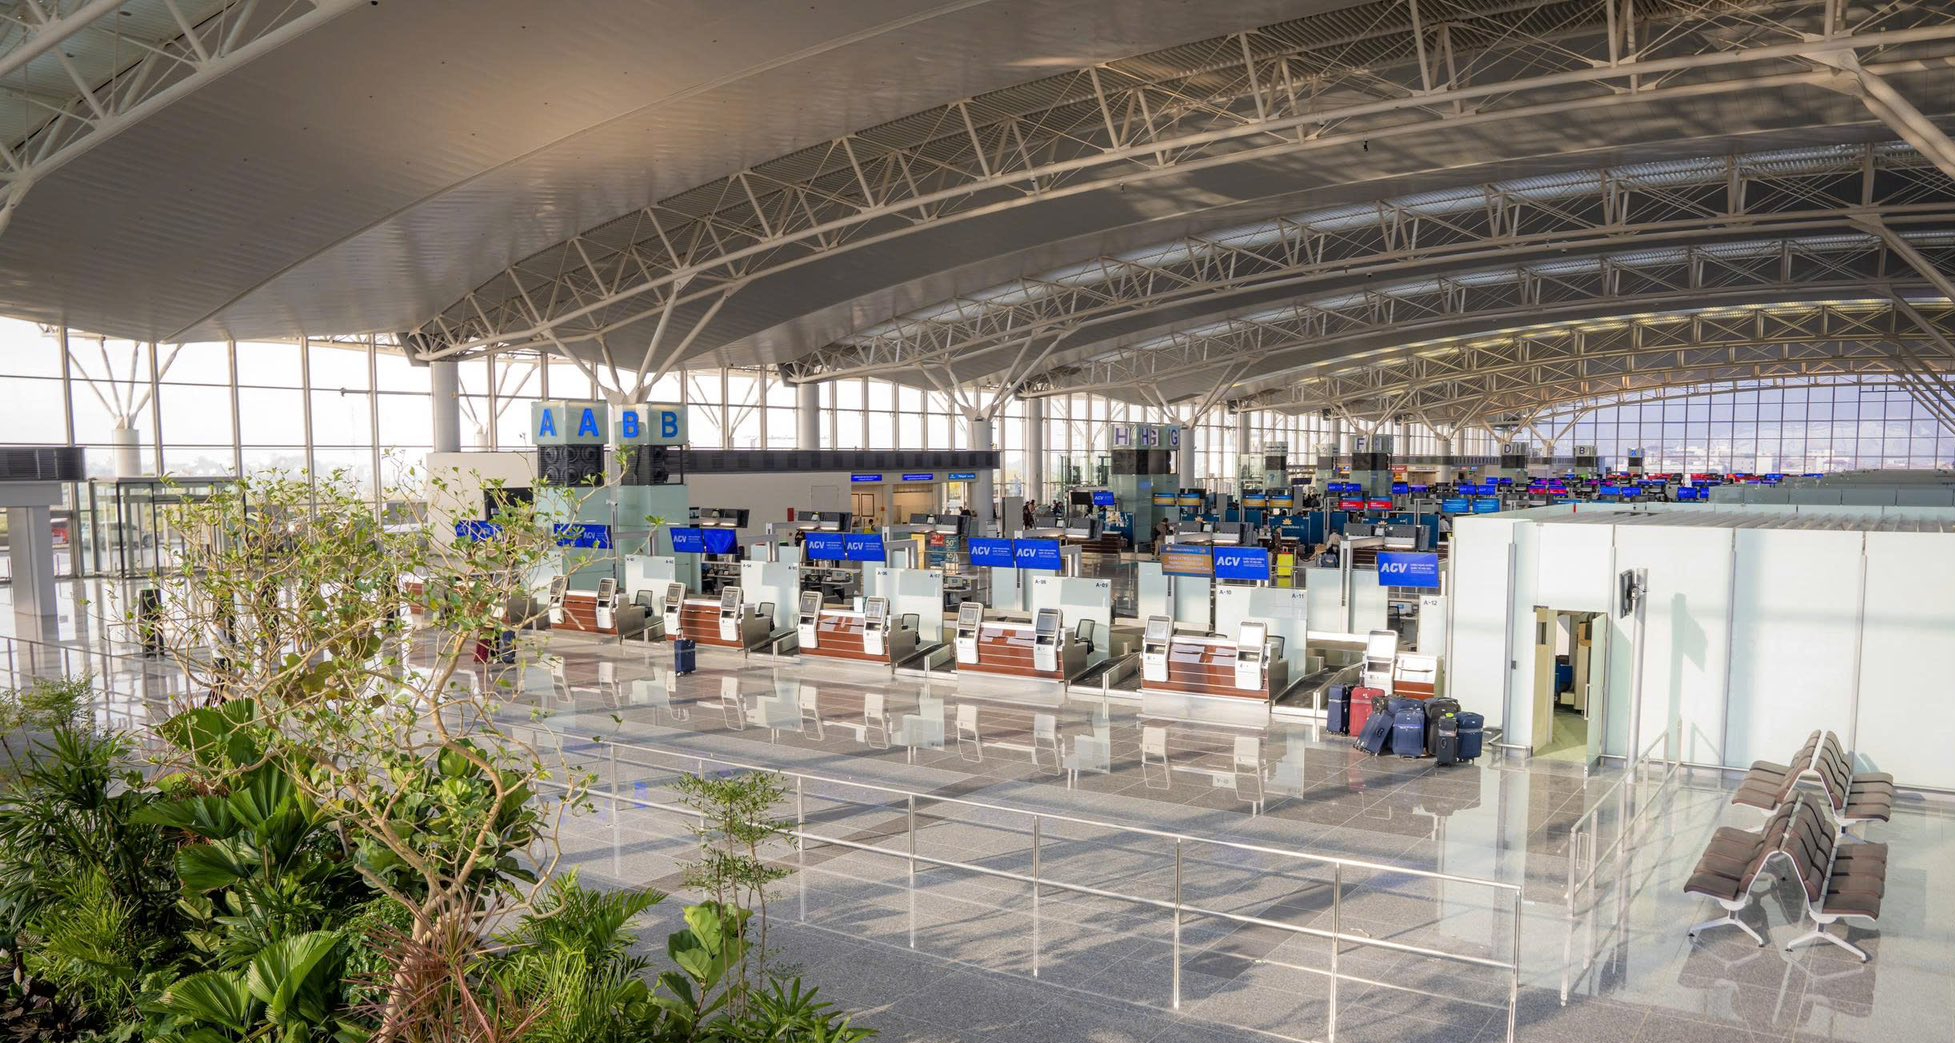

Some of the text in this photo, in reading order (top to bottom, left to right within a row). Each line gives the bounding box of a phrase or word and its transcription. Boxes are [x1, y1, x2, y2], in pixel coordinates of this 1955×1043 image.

[539, 408, 557, 437] A
[578, 408, 599, 437] A
[623, 411, 639, 438] B
[662, 411, 678, 438] B
[1115, 428, 1128, 444] H
[1142, 428, 1149, 445] H
[1171, 429, 1178, 445] G
[1357, 438, 1365, 450] F
[1504, 444, 1511, 453] D
[673, 535, 687, 543] ACV
[808, 541, 825, 549] ACV
[847, 542, 864, 550] ACV
[971, 546, 990, 555] ACV
[1016, 548, 1036, 557] ACV
[1216, 556, 1240, 566] ACV
[1380, 562, 1407, 573] ACV
